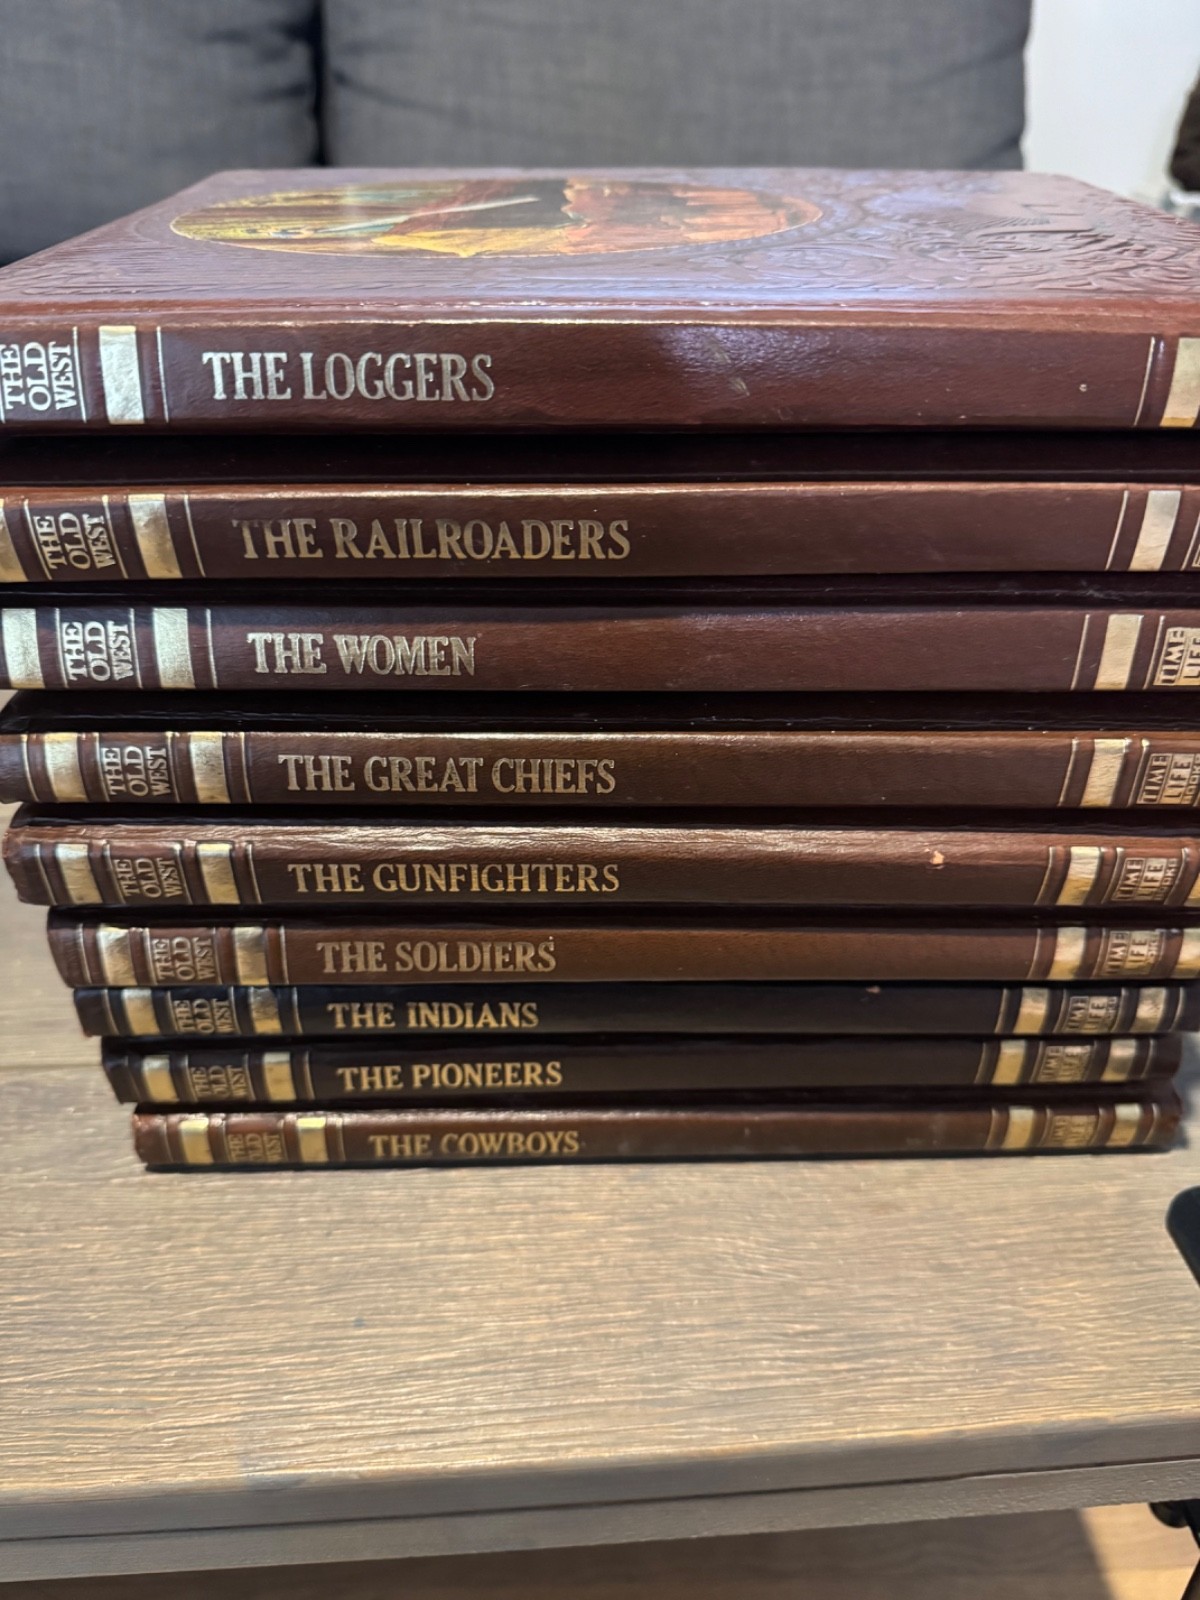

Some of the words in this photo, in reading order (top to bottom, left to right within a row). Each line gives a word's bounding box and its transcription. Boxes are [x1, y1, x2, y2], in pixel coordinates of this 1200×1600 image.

[0, 343, 26, 409] THE
[23, 341, 51, 411] OLD
[48, 341, 77, 410] WEST
[202, 351, 291, 400] THE
[300, 351, 495, 401] LOGGERS
[33, 515, 60, 570] THE
[58, 512, 92, 570] OLD
[82, 513, 117, 569] WEST
[232, 517, 323, 559] THE
[329, 517, 631, 560] RAILROADERS
[62, 621, 88, 681] THE
[84, 620, 111, 682] OLD
[107, 620, 134, 681] WEST
[247, 632, 327, 675] THE
[333, 633, 477, 676] WOMEN
[1160, 629, 1185, 685] TIME
[100, 747, 127, 796] THE
[124, 745, 149, 797] OLD
[146, 746, 172, 797] WEST
[278, 754, 355, 792] THE
[363, 756, 484, 793] GREAT
[492, 757, 616, 794] CHIEFS
[1142, 755, 1169, 803] TIME
[1163, 760, 1191, 799] LIFE
[114, 858, 140, 897] THE
[134, 857, 162, 898] OLD
[156, 857, 184, 898] WEST
[287, 863, 364, 893] THE
[372, 863, 620, 893] GUNFIGHTERS
[1114, 859, 1142, 900] TIME
[152, 937, 175, 980] THE
[172, 936, 196, 981] OLD
[193, 936, 215, 981] WEST
[316, 941, 387, 973] THE
[395, 941, 556, 973] SOLDIERS
[174, 999, 196, 1033] THE
[193, 998, 215, 1034] OLD
[213, 998, 235, 1034] WEST
[327, 1002, 396, 1029] THE
[407, 1002, 539, 1029] INDIANS
[190, 1066, 211, 1098] THE
[337, 1065, 403, 1092] THE
[412, 1061, 563, 1088] PIONEERS
[368, 1134, 431, 1158] THE
[440, 1131, 579, 1157] COWBOYS
